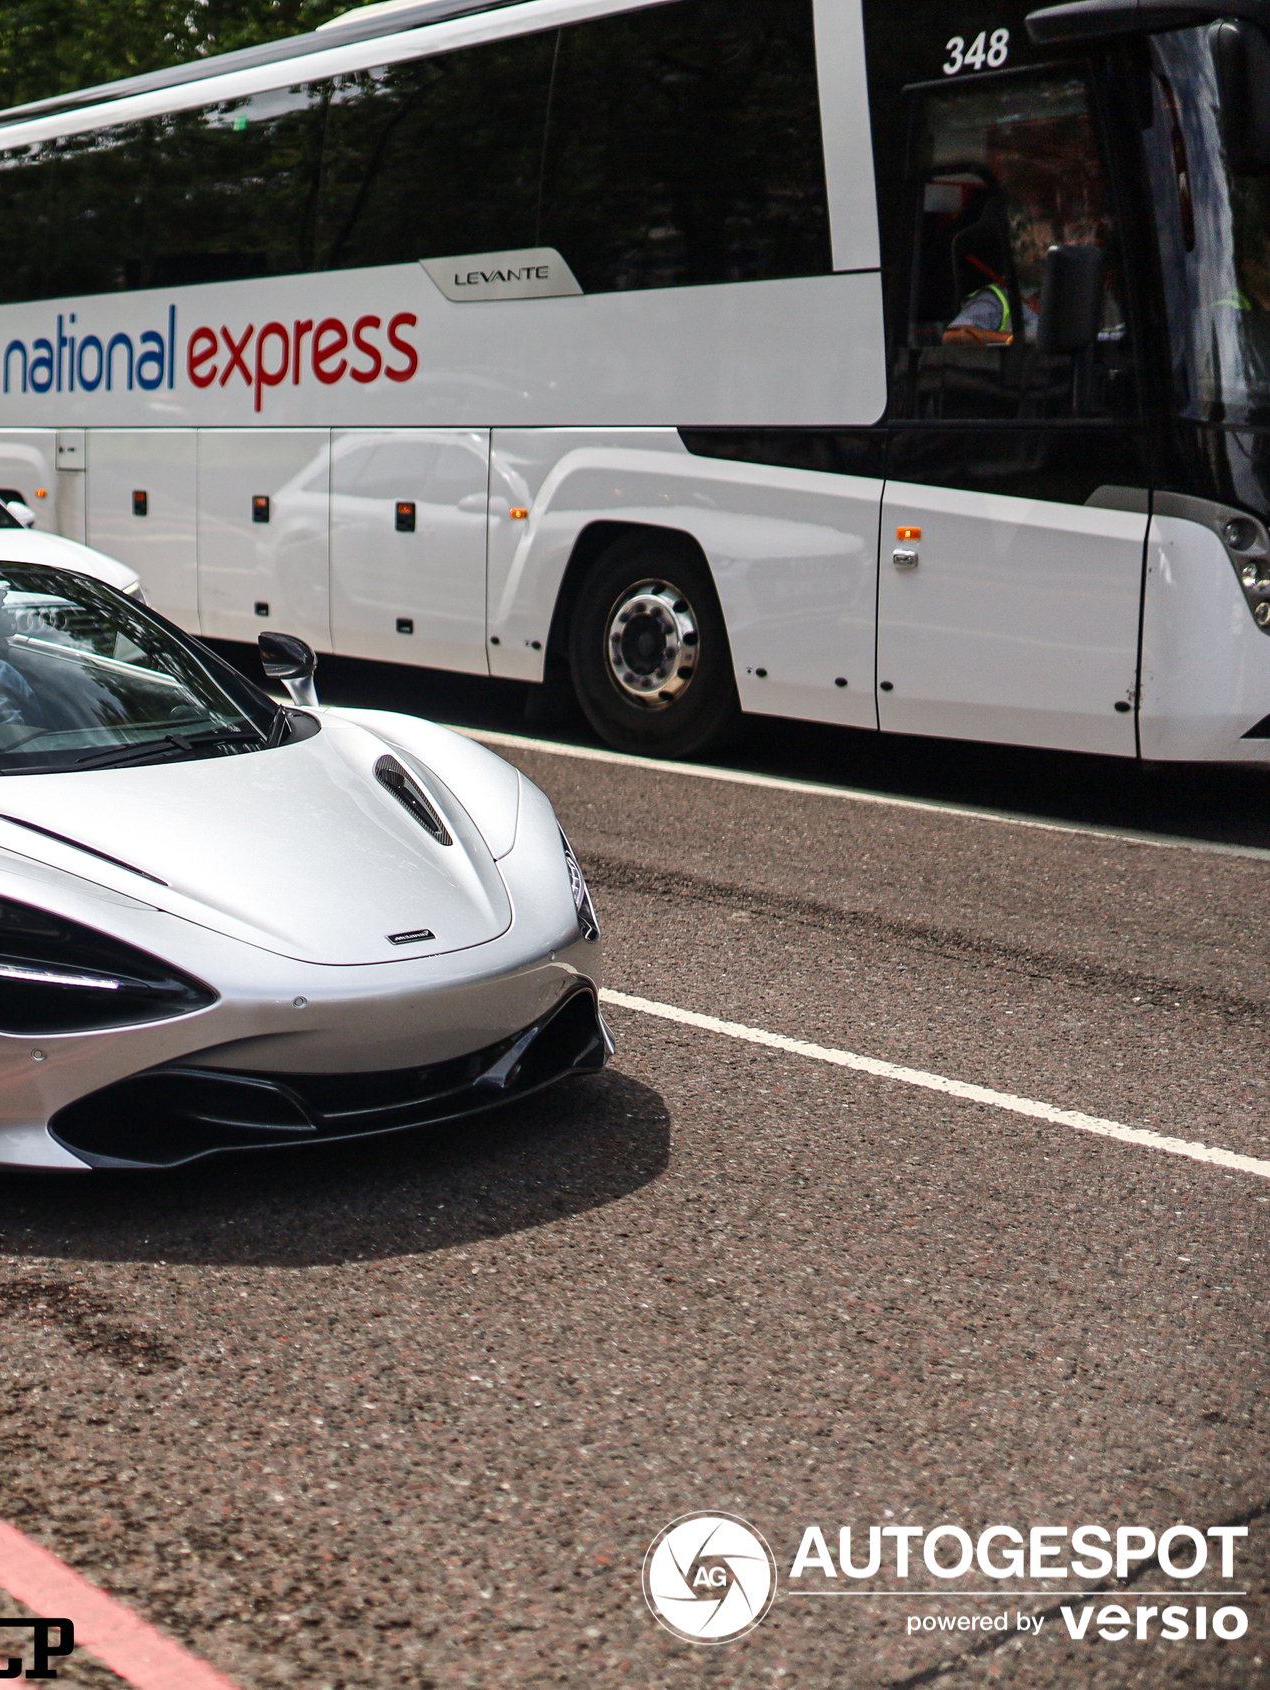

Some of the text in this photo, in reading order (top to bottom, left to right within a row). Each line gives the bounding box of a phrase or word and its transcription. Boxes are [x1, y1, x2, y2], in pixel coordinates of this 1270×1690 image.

[943, 27, 1010, 75] 348
[454, 265, 549, 286] LEVANTE
[3, 303, 419, 413] national express
